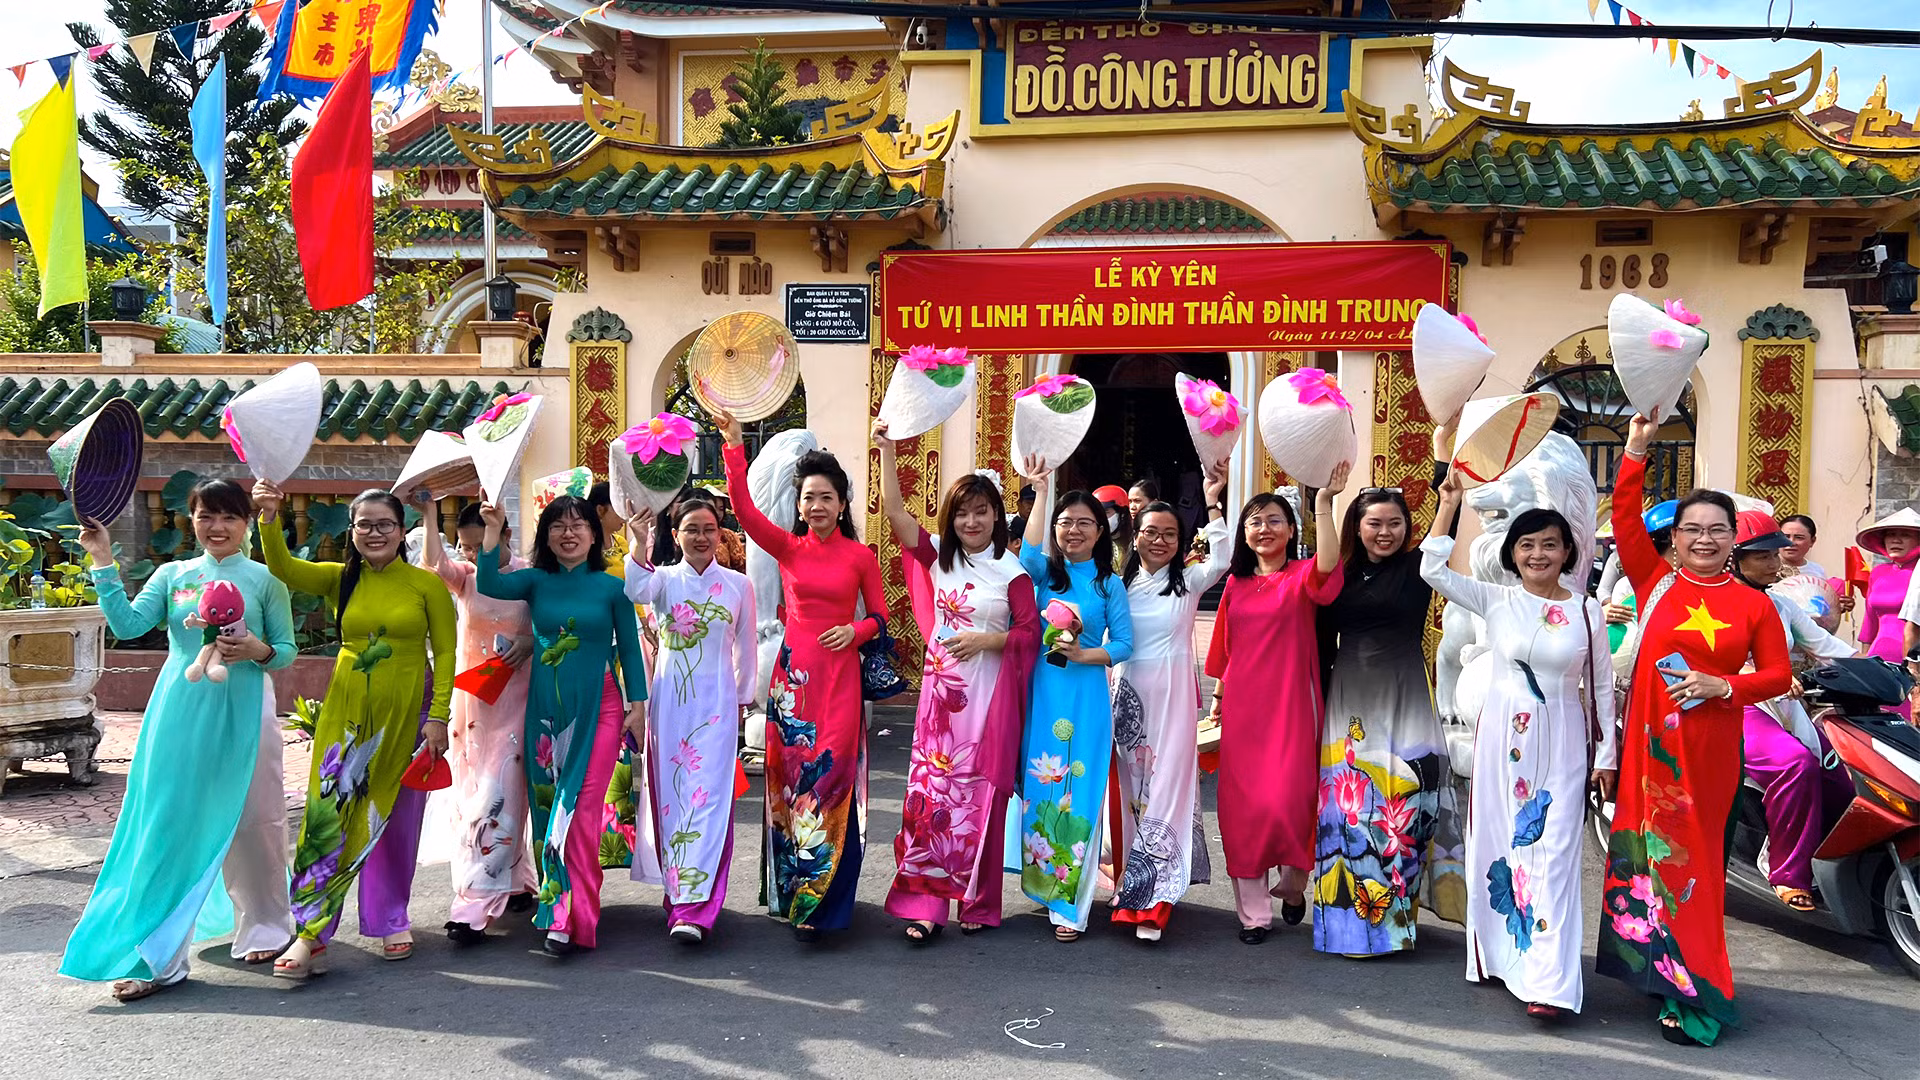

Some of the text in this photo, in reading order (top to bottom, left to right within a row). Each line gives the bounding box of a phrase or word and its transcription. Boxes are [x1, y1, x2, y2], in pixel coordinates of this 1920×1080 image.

[1184, 40, 1316, 107] TƯỜNG
[1095, 257, 1217, 288] LỄ KỲ YÊN
[805, 310, 851, 318] Giờ Chiêm Bái
[898, 300, 932, 328] TỨ
[939, 305, 962, 333] VỊ
[971, 304, 1027, 328] LINH
[1036, 294, 1103, 327] THẦN
[1112, 296, 1174, 326] ĐÌNH
[1184, 291, 1254, 325] THẦN
[1263, 294, 1327, 324] ĐÌNH
[795, 327, 806, 335] TỐI
[817, 328, 829, 336] GIỜ
[1268, 330, 1313, 342] Ngày
